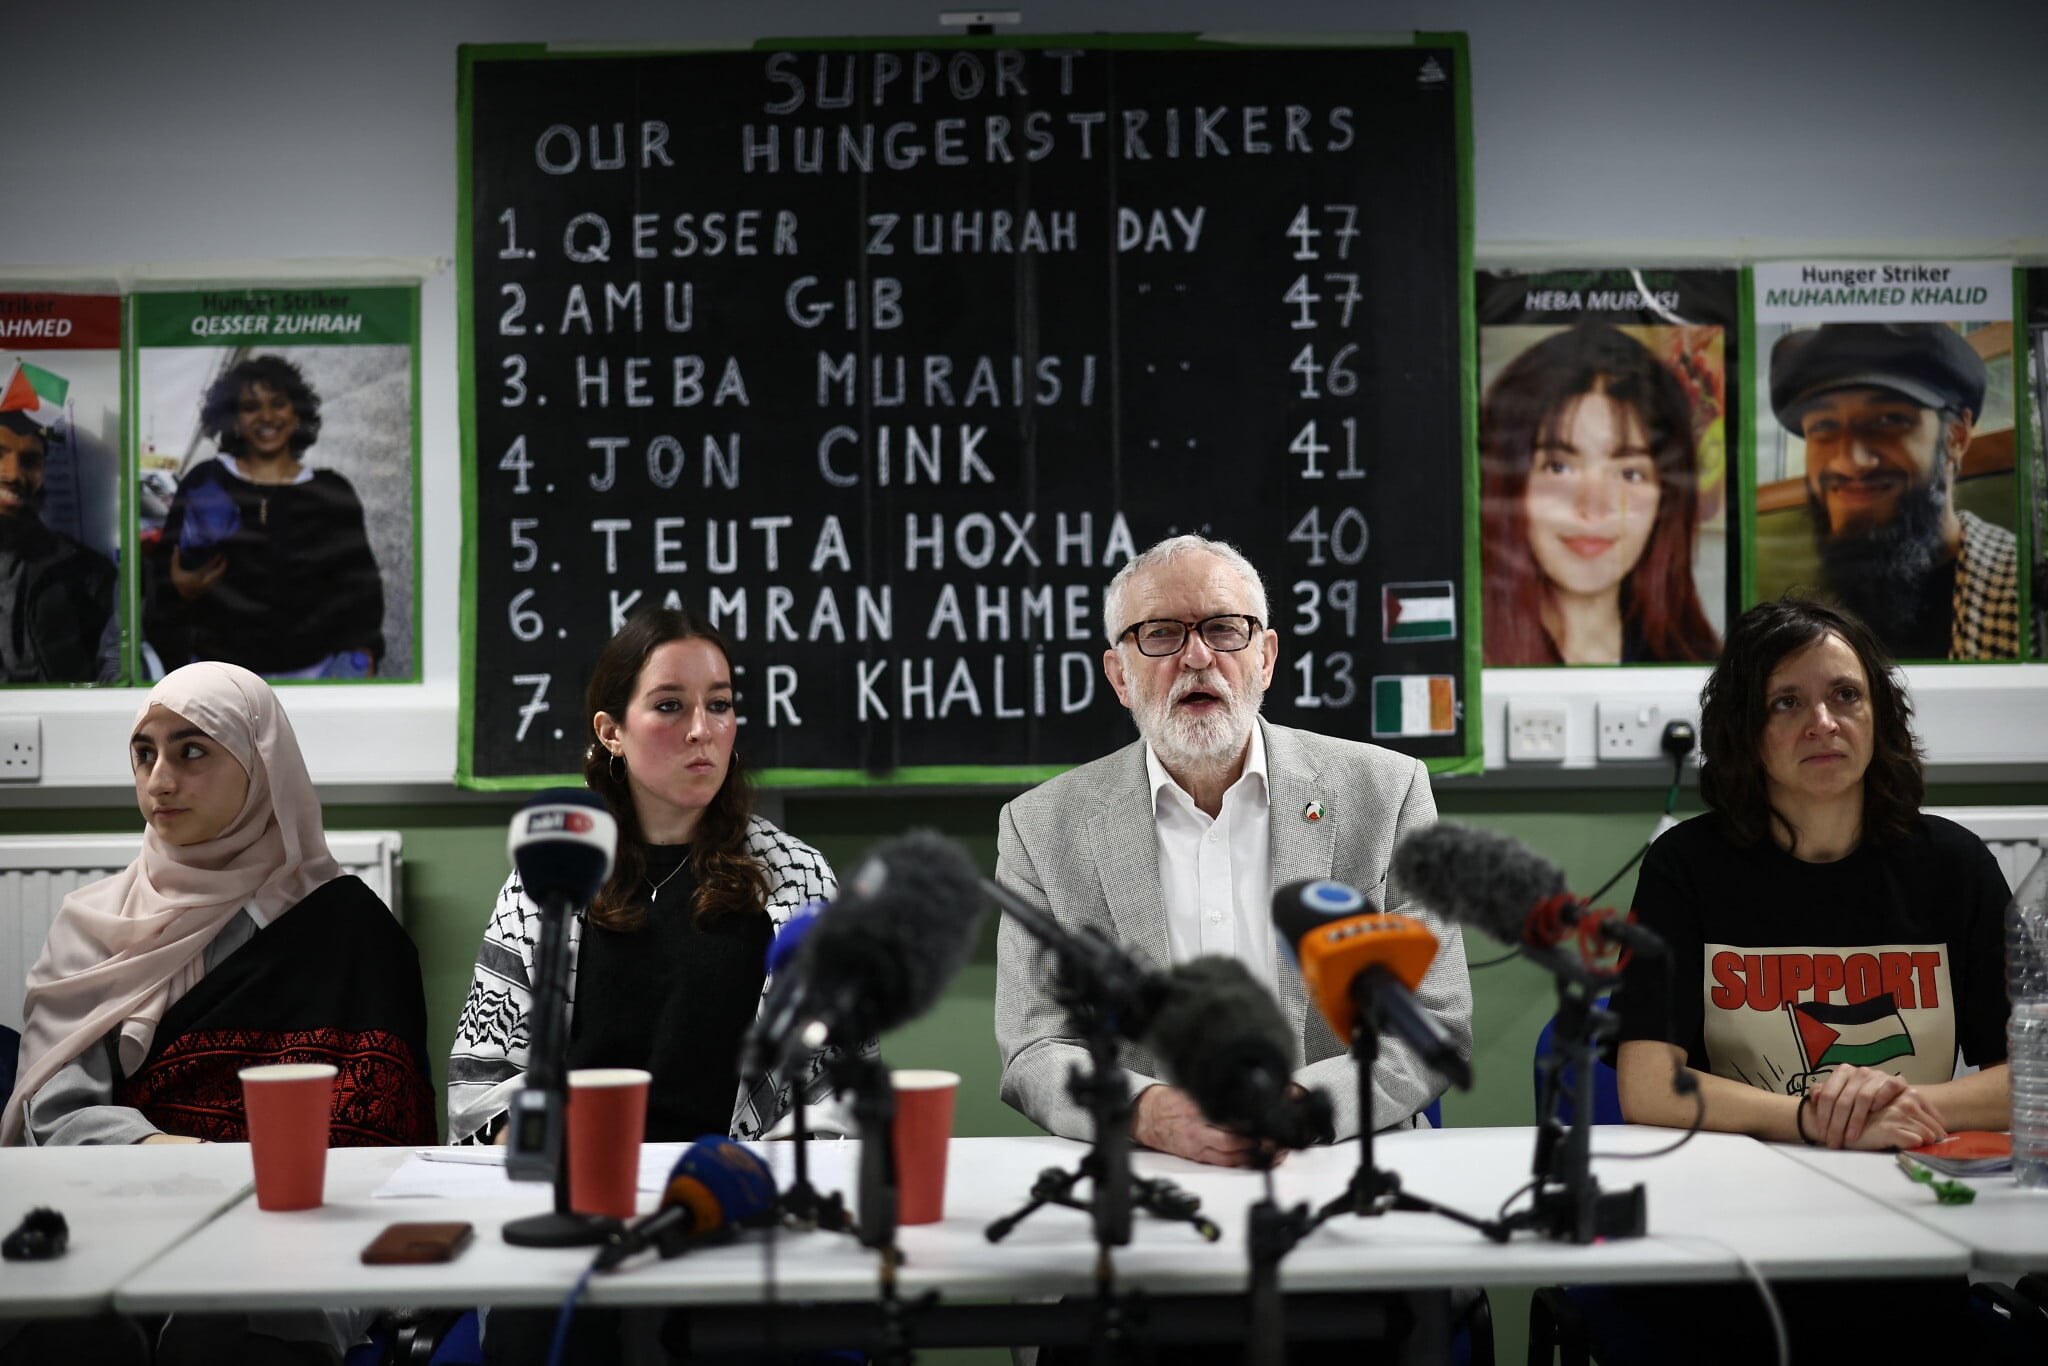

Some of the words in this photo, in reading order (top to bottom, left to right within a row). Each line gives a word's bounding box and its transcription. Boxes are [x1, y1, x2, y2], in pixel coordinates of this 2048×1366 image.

[763, 49, 1086, 115] SUPPORT
[535, 120, 675, 175] OUR
[742, 105, 1355, 173] HUNGERSTRIKERS
[498, 207, 537, 260] 1.
[563, 210, 799, 263] QESSER
[866, 210, 1077, 255] ZUHRAH
[1117, 206, 1205, 253] DAY
[1285, 204, 1361, 261] 47
[499, 282, 545, 336] 2.
[559, 280, 694, 335] AMU
[785, 275, 904, 329] GIB
[1282, 273, 1363, 330] 47
[1525, 289, 1582, 312] HEBA
[1765, 287, 1906, 308] MUHAMMED
[1911, 286, 1988, 305] KHALID
[1802, 265, 1877, 286] Hunger
[1882, 264, 1952, 283] Striker
[191, 314, 270, 337] QESSER
[272, 313, 362, 334] ZUHRAH
[501, 353, 547, 408] 3.
[576, 355, 750, 408] HEBA
[818, 351, 1096, 407] MURAISI
[1289, 343, 1359, 399] 46
[498, 434, 555, 494] 4.
[587, 432, 741, 492] JON
[818, 424, 995, 487] CINK
[1288, 417, 1366, 480] 41
[510, 518, 562, 573] 5.
[590, 514, 852, 575] TEUTA
[905, 510, 1137, 572] HOXHA
[1287, 506, 1369, 566] 40
[508, 587, 568, 642] 6.
[926, 583, 1107, 643] AHME
[1292, 579, 1359, 638] 39
[511, 673, 565, 742] 7.
[1293, 650, 1357, 708] 13
[1711, 950, 1941, 1012] SUPPORT
